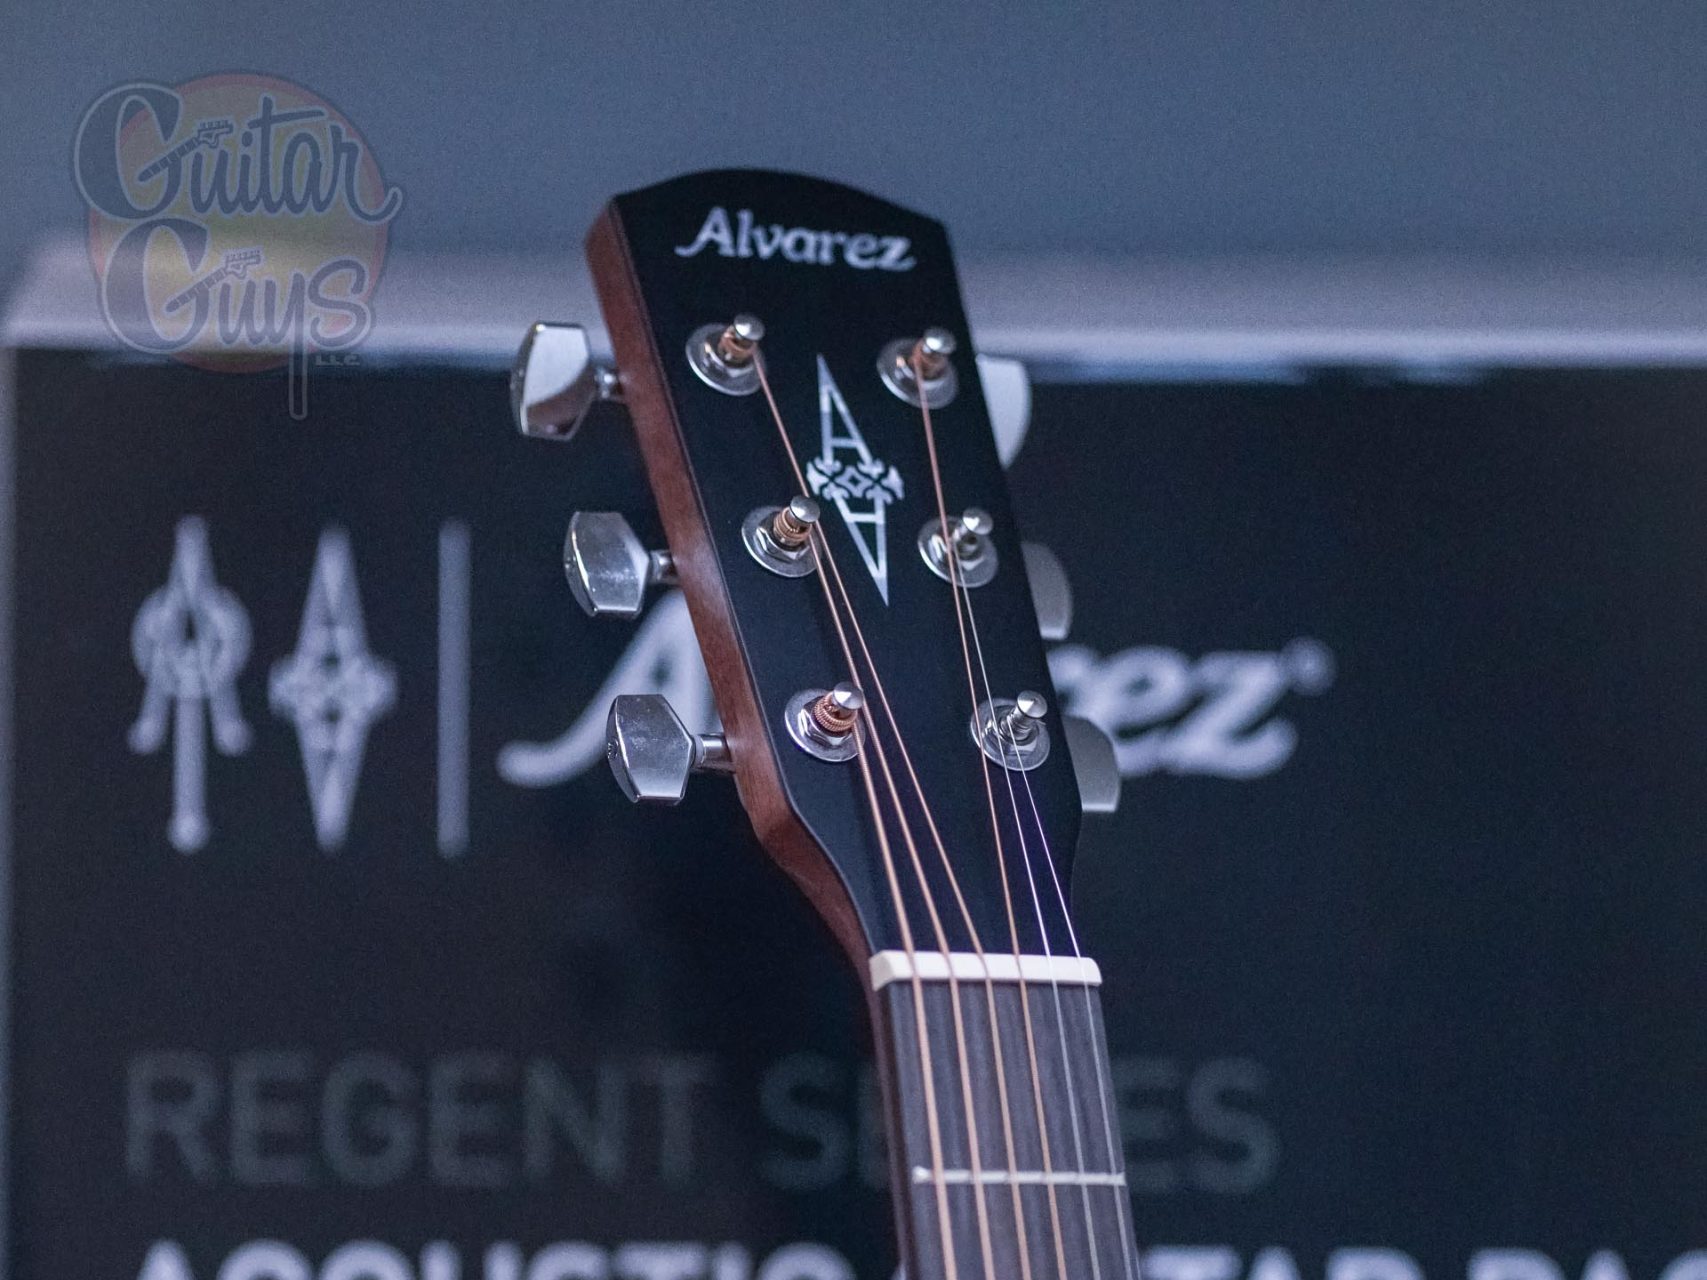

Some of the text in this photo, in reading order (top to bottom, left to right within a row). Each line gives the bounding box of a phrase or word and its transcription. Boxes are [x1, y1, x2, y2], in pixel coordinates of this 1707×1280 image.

[674, 206, 917, 272] Alvarez
[124, 1052, 1280, 1193] REGENT SES
